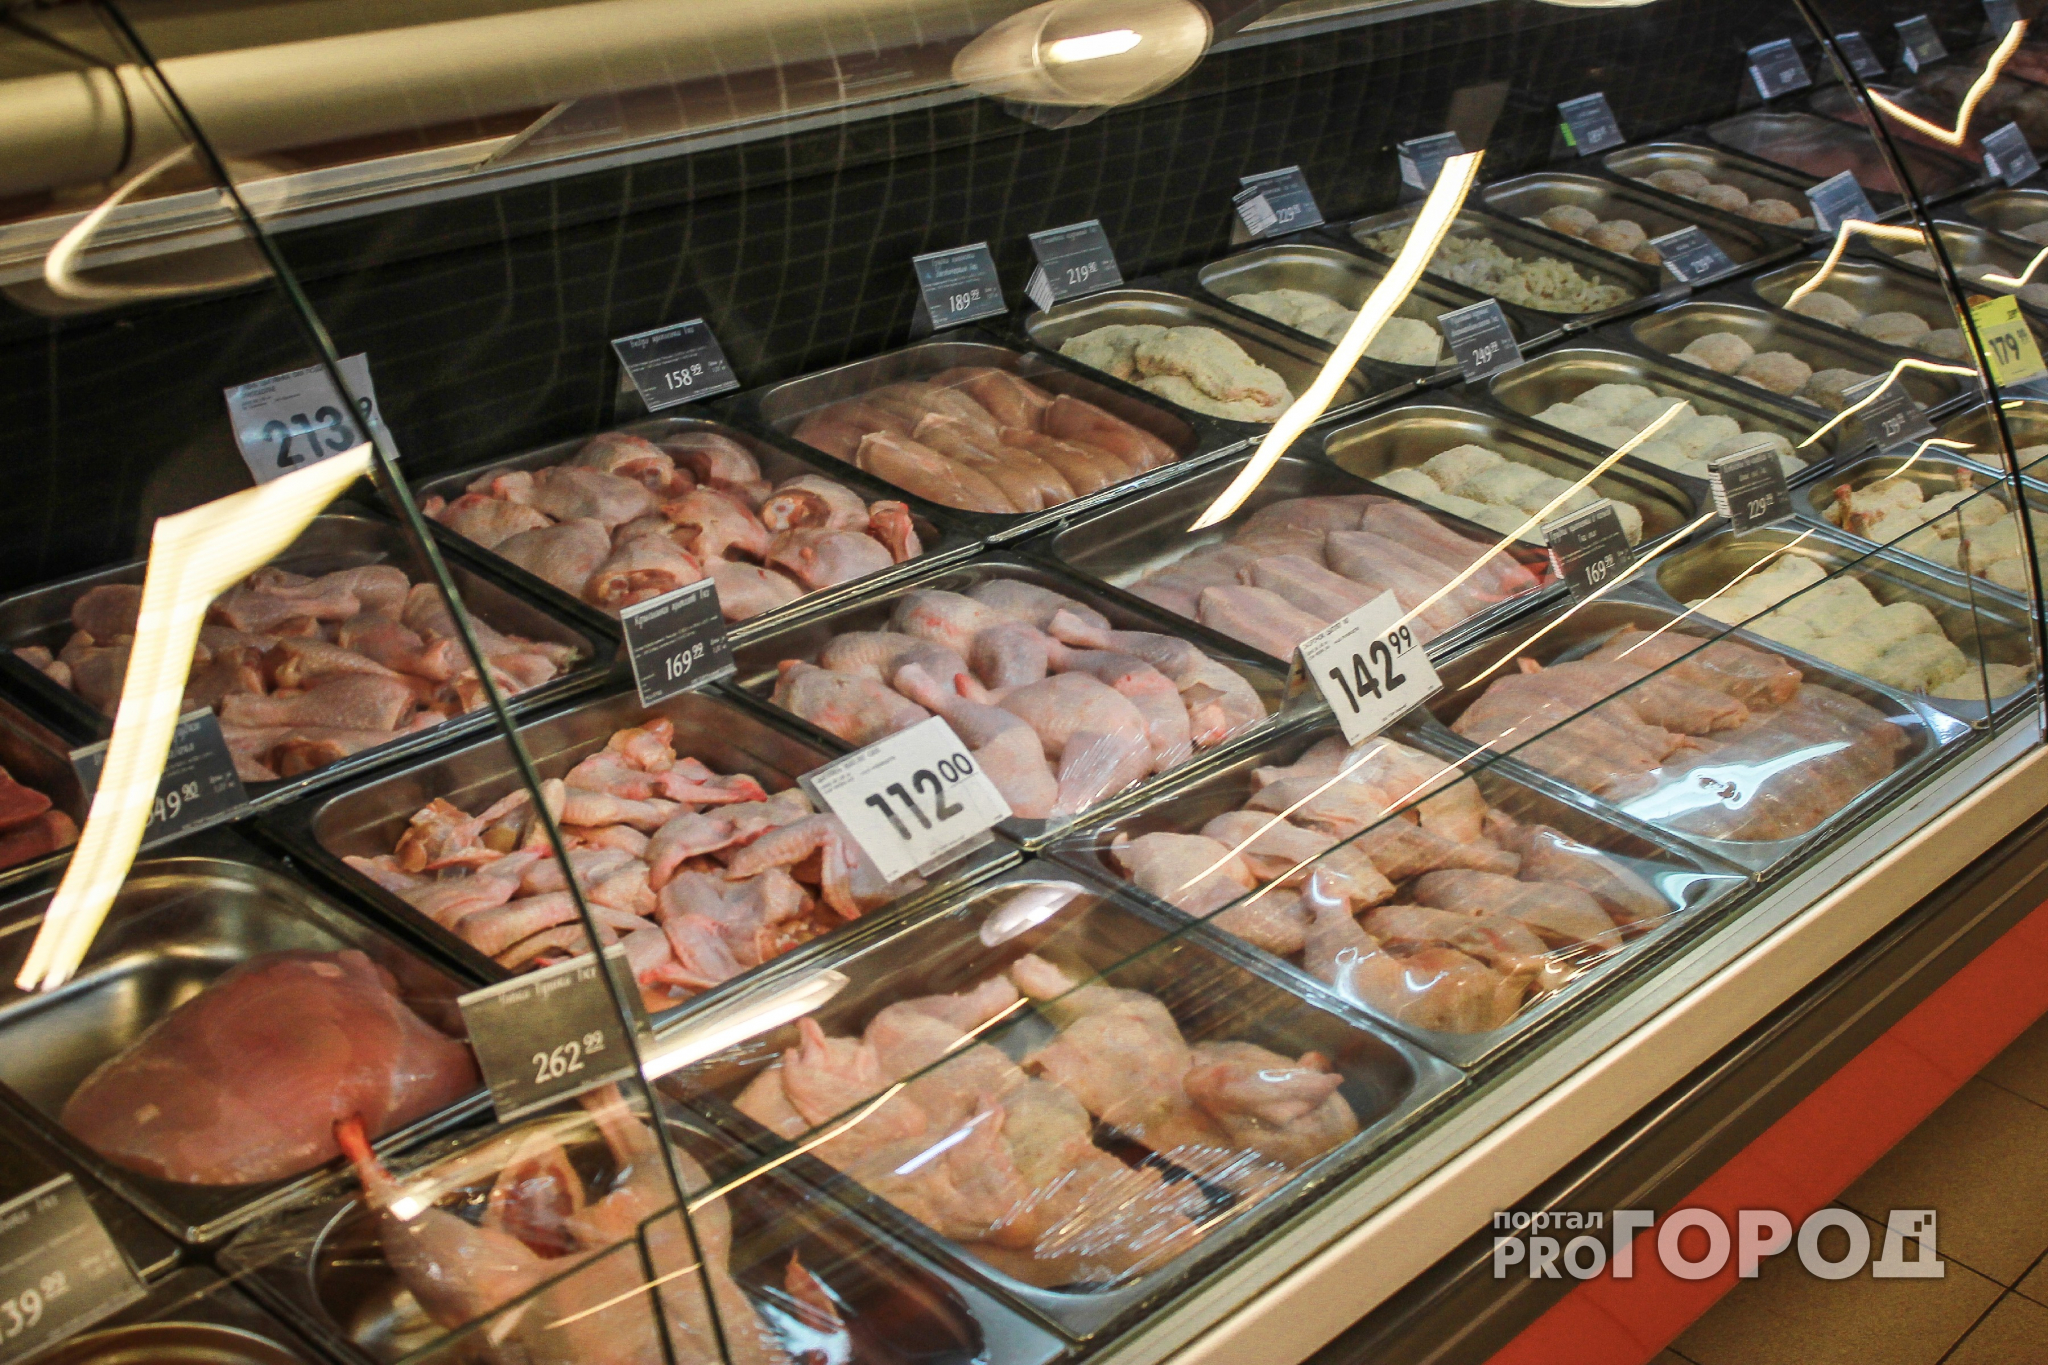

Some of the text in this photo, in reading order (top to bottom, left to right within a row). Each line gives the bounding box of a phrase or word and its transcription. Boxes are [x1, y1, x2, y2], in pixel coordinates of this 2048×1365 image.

[1066, 265, 1089, 285] 219
[949, 292, 970, 313] 189
[1472, 346, 1492, 366] 249
[1988, 332, 2020, 365] 179
[664, 370, 693, 390] 158
[690, 363, 703, 376] 99
[262, 405, 355, 468] 213
[1585, 559, 1607, 586] 169
[665, 649, 693, 681] 169
[691, 642, 704, 657] 99
[1329, 640, 1406, 713] 142
[1388, 625, 1411, 654] 99
[145, 791, 182, 828] 49
[865, 769, 964, 840] 112
[937, 753, 973, 782] 00
[532, 1040, 585, 1084] 262
[0, 1288, 43, 1344] 39
